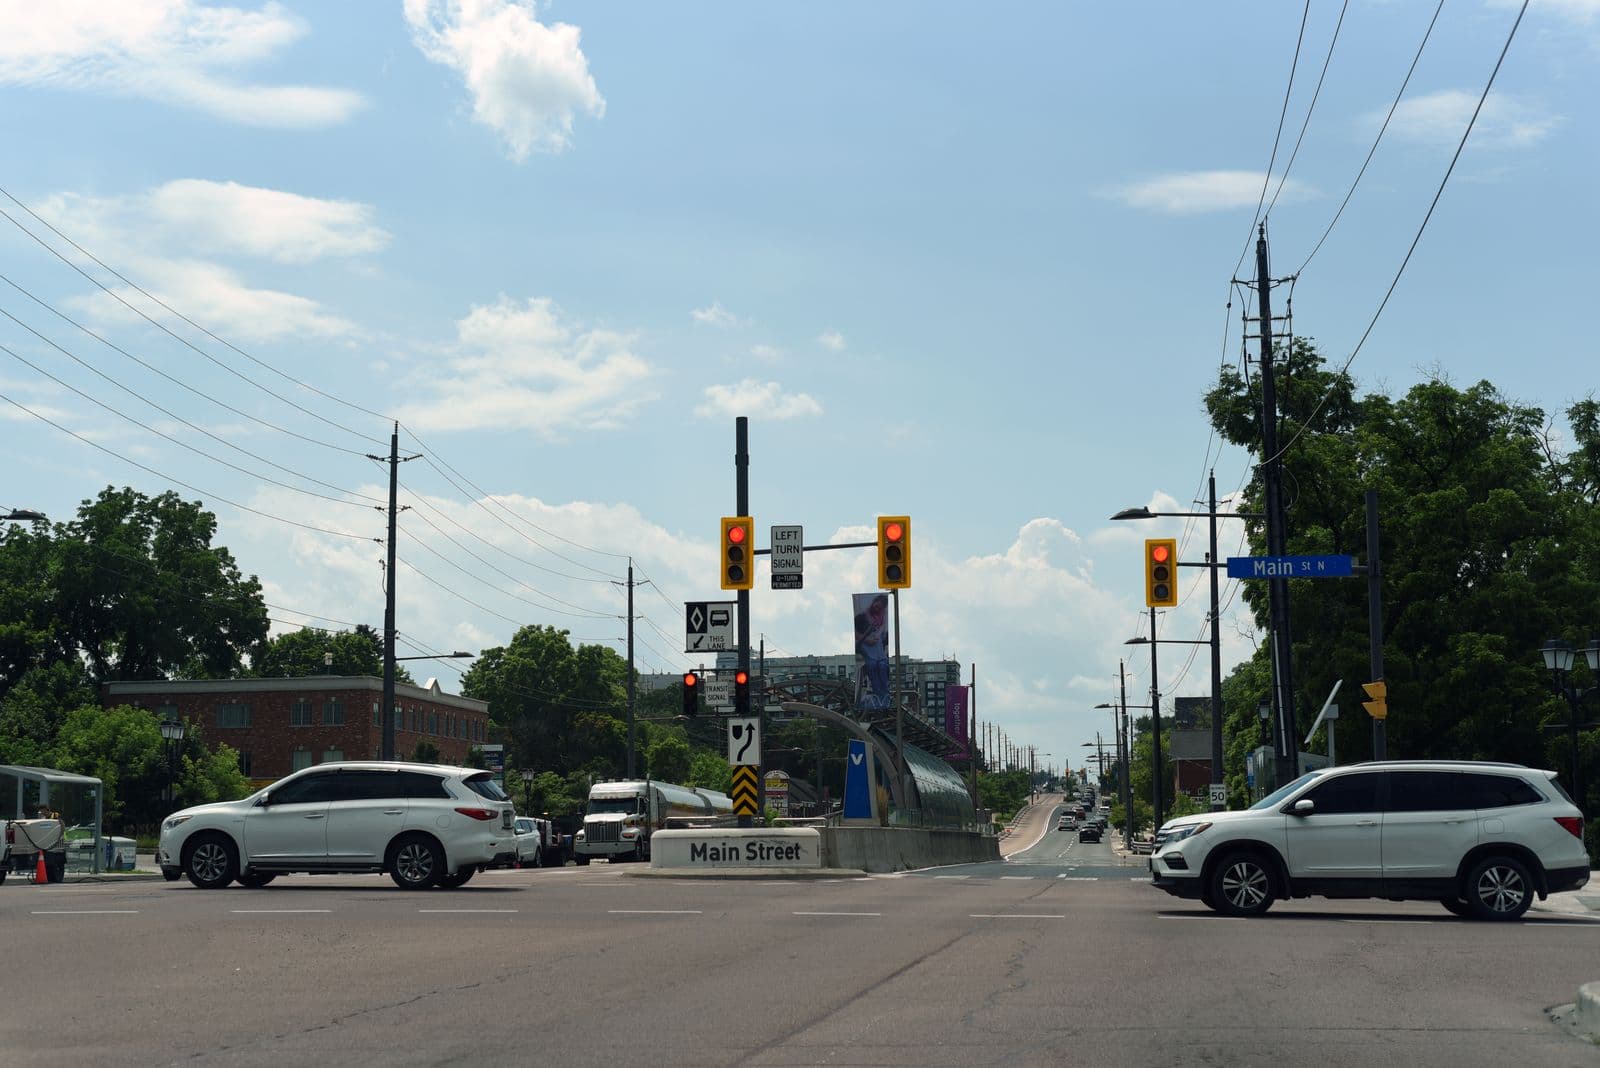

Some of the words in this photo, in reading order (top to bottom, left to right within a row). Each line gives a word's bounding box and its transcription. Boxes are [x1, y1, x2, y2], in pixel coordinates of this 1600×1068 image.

[775, 531, 798, 540] LEFT
[775, 545, 800, 554] TURN
[773, 559, 801, 568] SIGNAL
[1254, 558, 1293, 576] Main
[1301, 561, 1311, 571] St
[1317, 561, 1325, 571] N
[1211, 791, 1225, 802] 50
[690, 842, 740, 862] Main
[745, 842, 801, 861] Street
